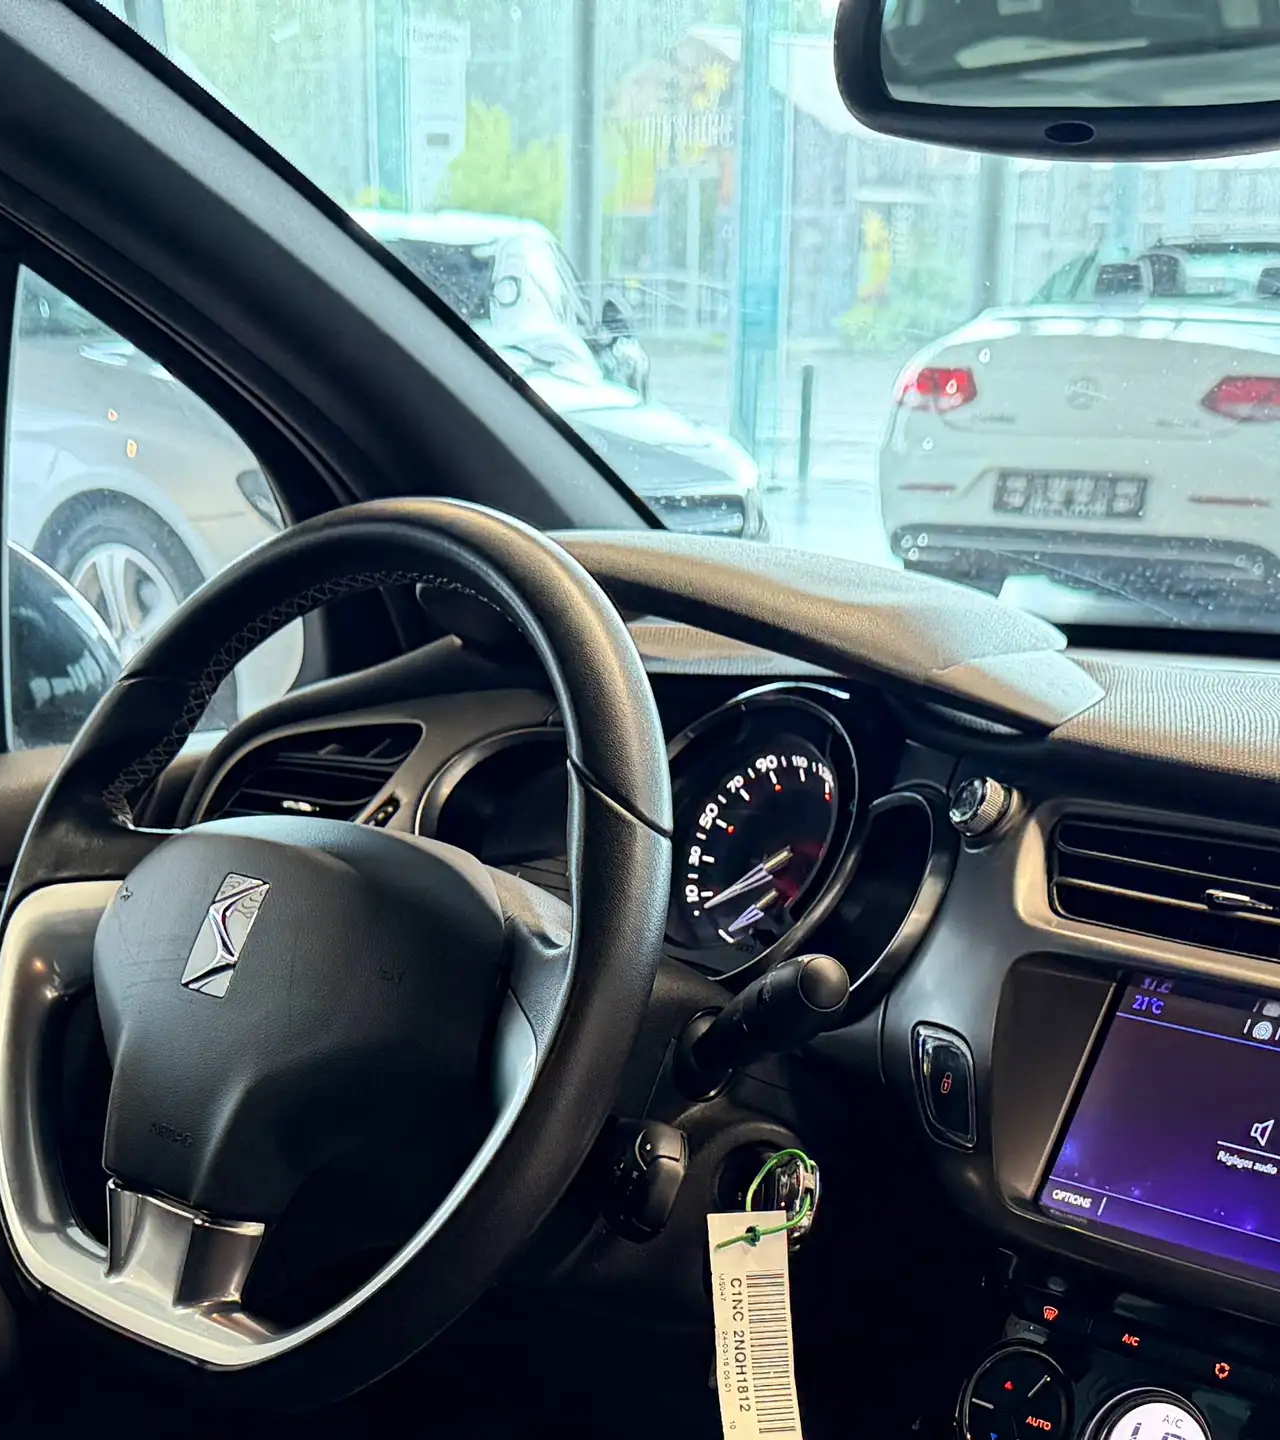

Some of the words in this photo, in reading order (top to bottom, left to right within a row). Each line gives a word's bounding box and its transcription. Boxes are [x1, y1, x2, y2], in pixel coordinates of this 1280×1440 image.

[755, 754, 778, 772] 90
[791, 754, 809, 769] 110
[726, 774, 745, 793] 70
[698, 802, 719, 830] 50
[688, 845, 702, 868] 30
[685, 884, 700, 903] 10
[1131, 994, 1165, 1015] 21°C
[1253, 1160, 1278, 1176] audio
[1051, 1188, 1093, 1210] OPTIONS
[729, 1277, 745, 1323] C1NC
[1121, 1332, 1141, 1348] A/C
[733, 1329, 752, 1413] 2NQH1812
[1025, 1415, 1052, 1431] AUTO
[1161, 1413, 1185, 1430] A/C
